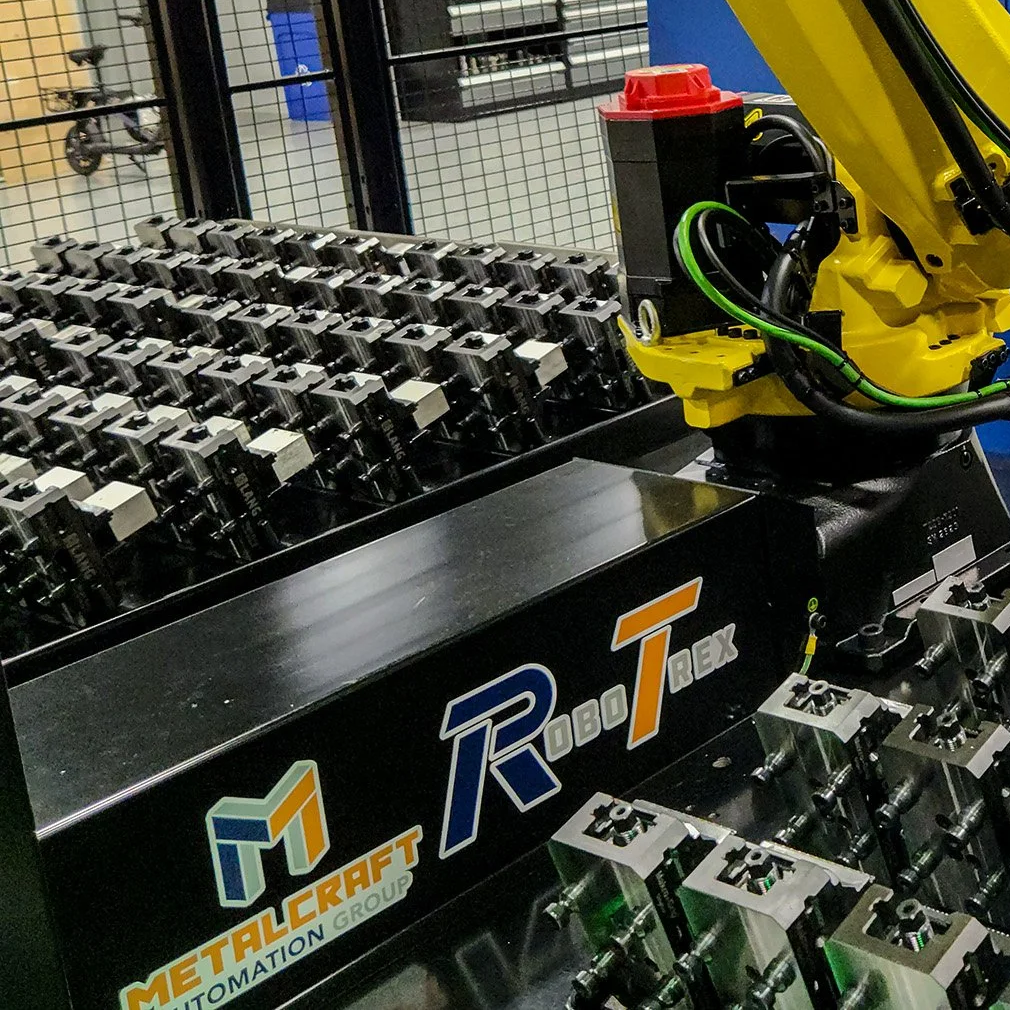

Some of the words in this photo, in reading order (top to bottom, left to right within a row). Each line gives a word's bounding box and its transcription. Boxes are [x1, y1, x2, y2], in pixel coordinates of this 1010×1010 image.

[126, 828, 419, 1010] METALCRAFT
[148, 924, 325, 1010] TOMATION
[332, 874, 411, 932] GROUP
